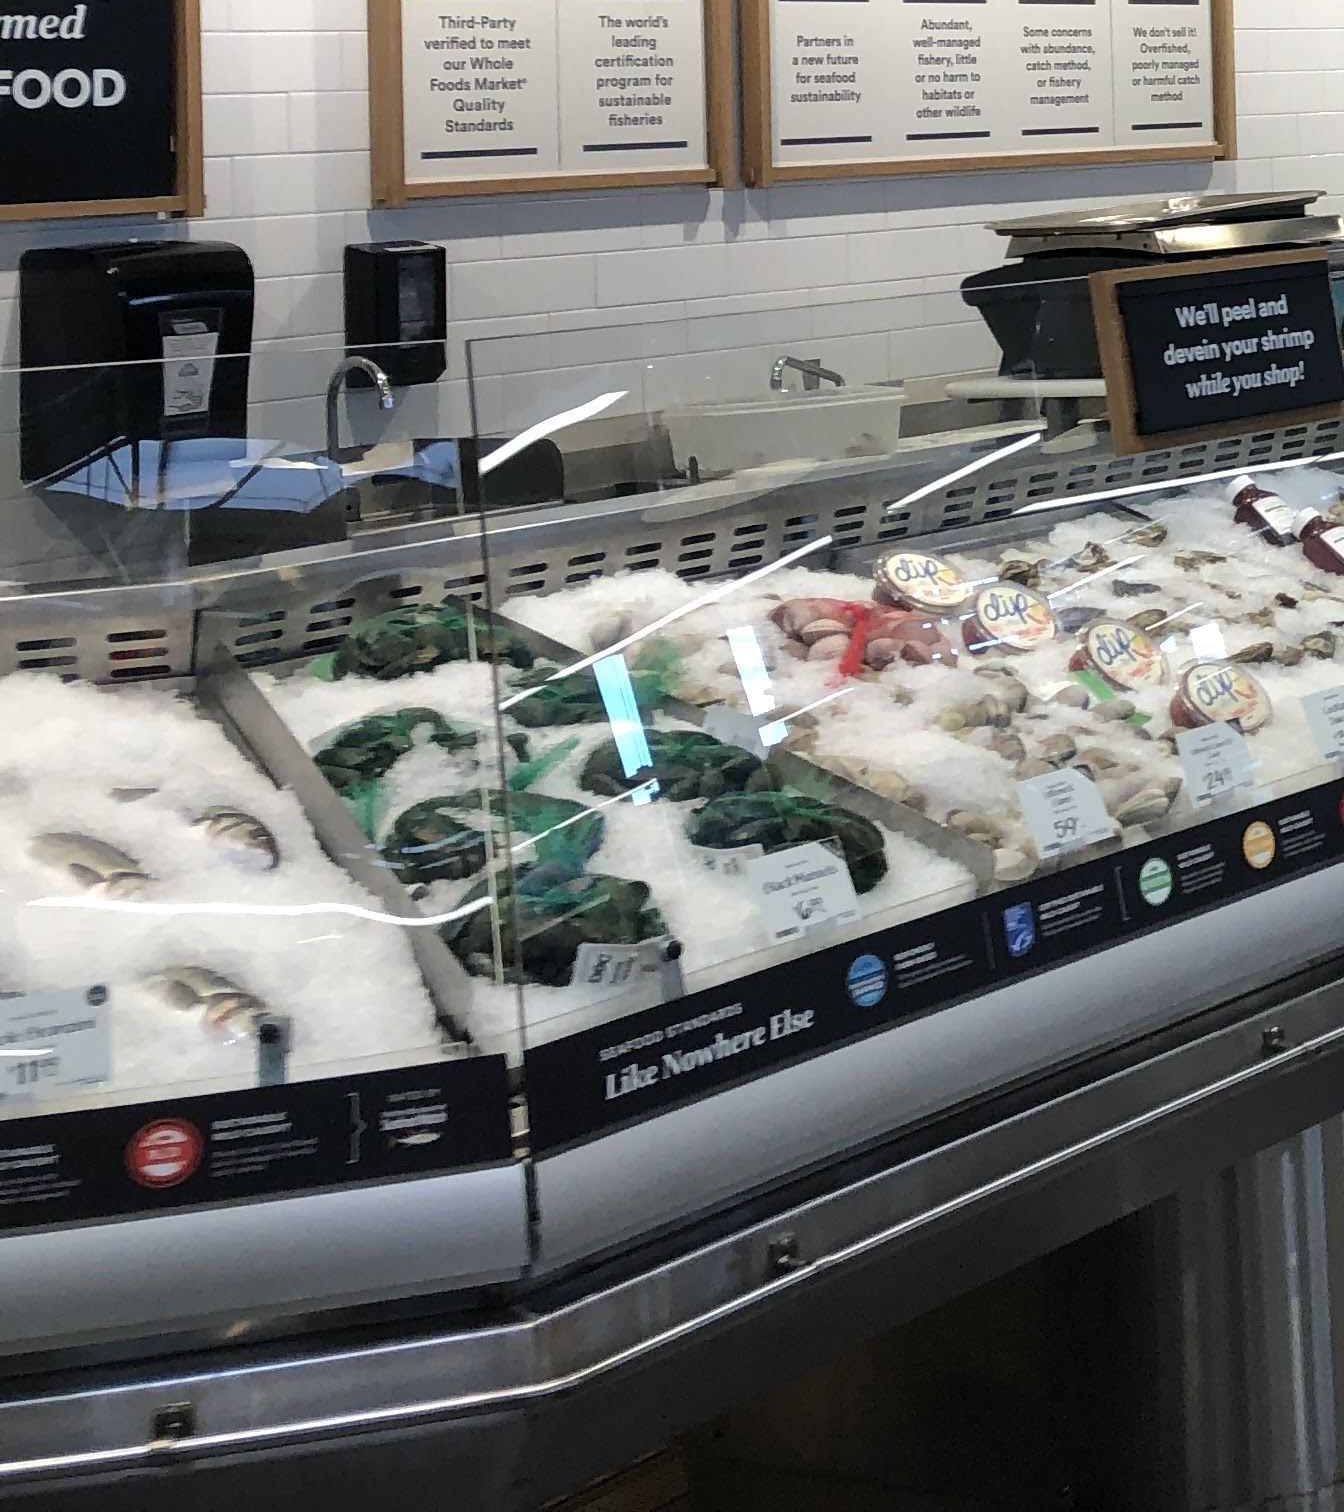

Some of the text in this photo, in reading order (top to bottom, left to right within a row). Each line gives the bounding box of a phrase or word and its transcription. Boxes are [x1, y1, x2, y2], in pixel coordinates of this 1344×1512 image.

[438, 15, 517, 31] Third-Party
[598, 15, 669, 28] The world's
[921, 19, 973, 31] Abundant,
[1023, 26, 1092, 38] Some concerns
[1133, 27, 1148, 37] We
[1149, 26, 1171, 37] don't
[1172, 26, 1186, 37] sell
[424, 36, 532, 49] verified to meet
[611, 35, 656, 50] leading
[797, 35, 854, 48] Partners in
[912, 37, 981, 50] well-managed
[1020, 43, 1096, 55] with abundance,
[1140, 43, 1192, 55] Overfished,
[443, 56, 513, 70] our Whole
[595, 55, 674, 68] certification
[801, 57, 823, 65] new
[826, 54, 859, 65] future
[918, 54, 977, 67] fishery, little
[1026, 60, 1092, 72] catch method,
[1132, 59, 1200, 72] poorly managed
[596, 74, 674, 90] program for
[796, 72, 856, 84] for seafood
[915, 72, 981, 83] or no harm to
[1049, 77, 1082, 89] fishery
[1143, 75, 1176, 86] harmful
[1177, 75, 1201, 85] catch
[430, 78, 471, 91] Foods
[598, 93, 672, 107] sustainable
[790, 90, 861, 103] sustainability
[922, 89, 975, 100] habitats or
[1030, 94, 1089, 106] management
[1151, 91, 1183, 101] method
[453, 98, 505, 114] Quality
[916, 106, 981, 118] other wildlife
[445, 118, 514, 133] Standards
[608, 113, 663, 126] fisheries
[1175, 294, 1289, 328] We'll peel and
[1163, 327, 1315, 366] devein your shrimp
[1185, 360, 1305, 398] while you shop!
[605, 1008, 815, 1100] Like Nowhere Else
